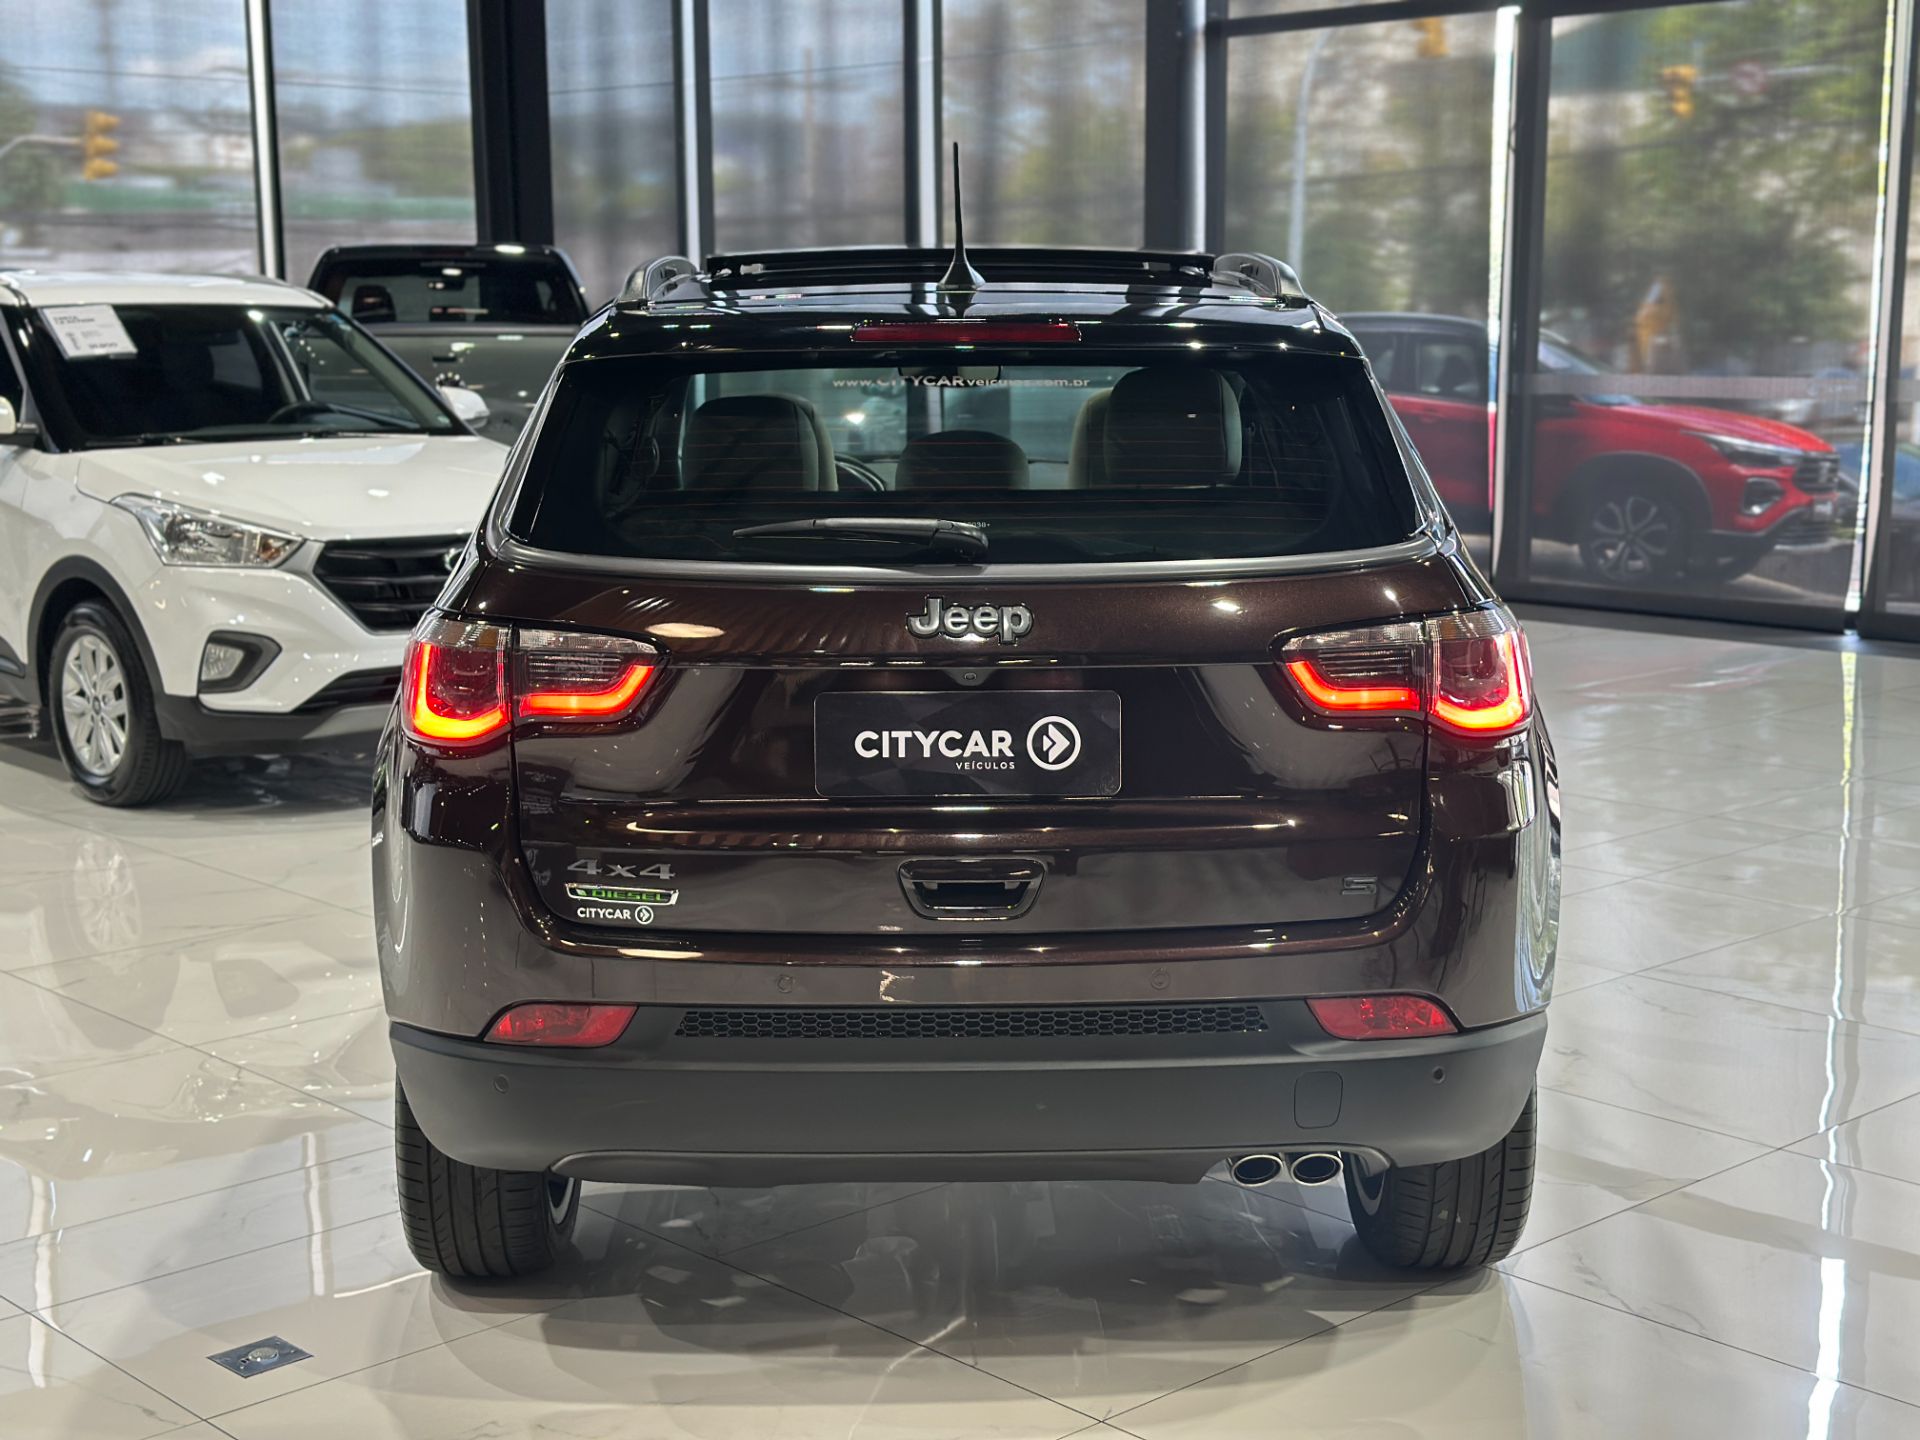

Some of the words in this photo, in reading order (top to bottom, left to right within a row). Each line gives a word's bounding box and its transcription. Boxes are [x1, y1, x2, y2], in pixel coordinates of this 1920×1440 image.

[907, 596, 1033, 645] Jeep
[854, 730, 1015, 758] CITYCAR
[956, 760, 1015, 770] VEÍCULOS
[577, 907, 632, 920] CITYCAR
